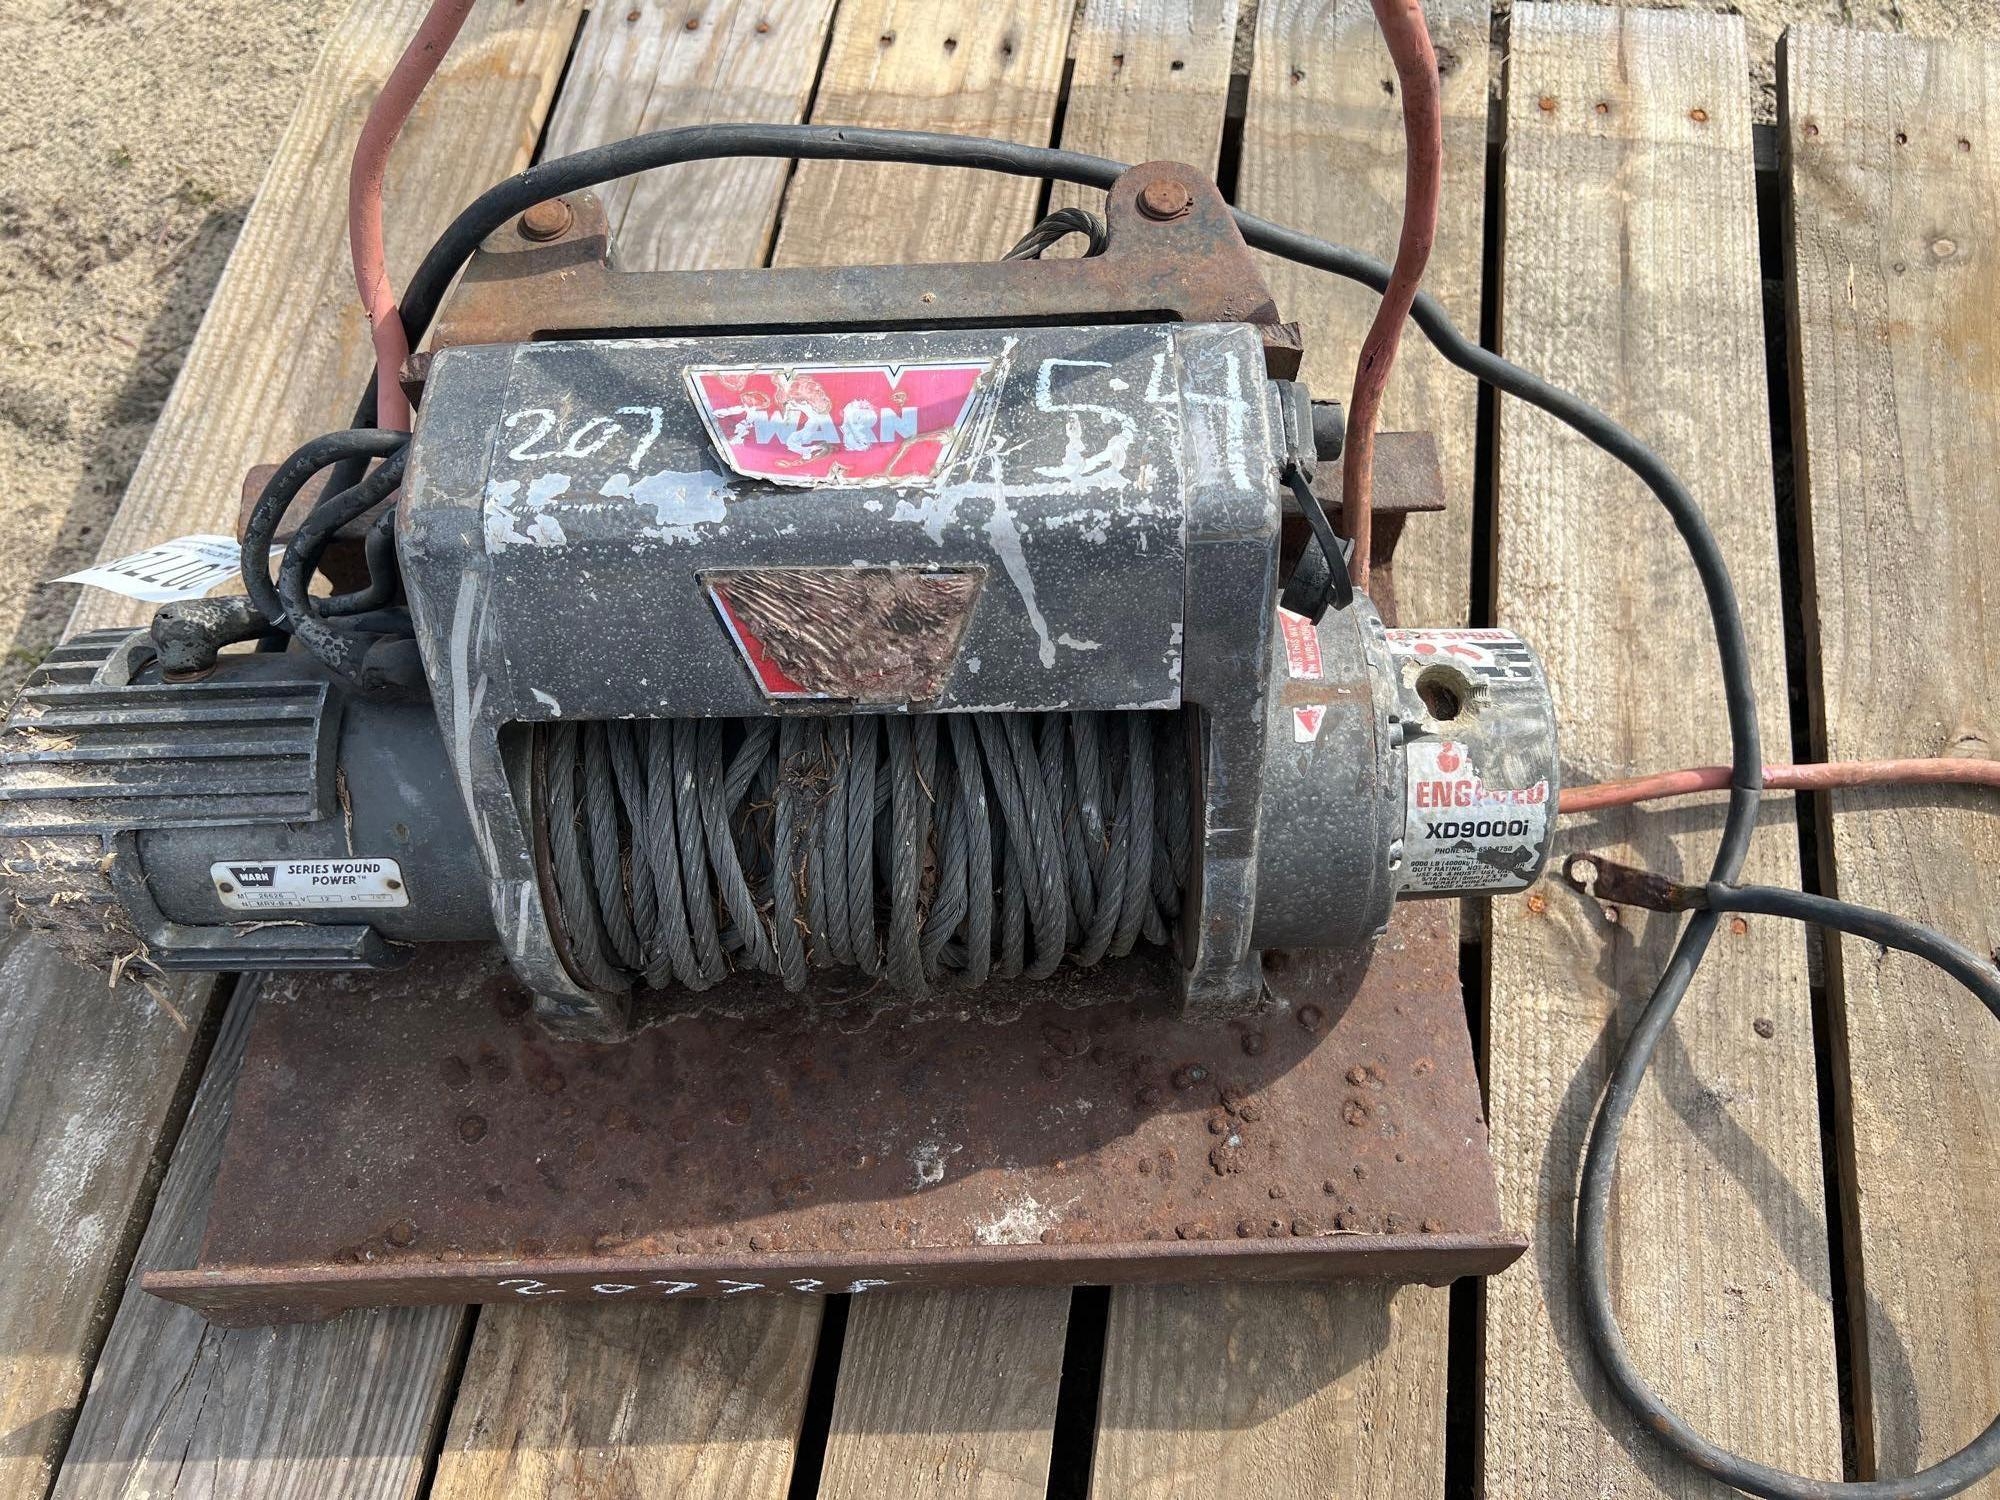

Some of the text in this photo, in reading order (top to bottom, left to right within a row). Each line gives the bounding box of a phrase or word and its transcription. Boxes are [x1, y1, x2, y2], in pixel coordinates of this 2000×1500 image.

[754, 407, 918, 445] WARN
[1425, 820, 1529, 839] XD9000i
[239, 863, 381, 882] WARN SERIES WOUND
